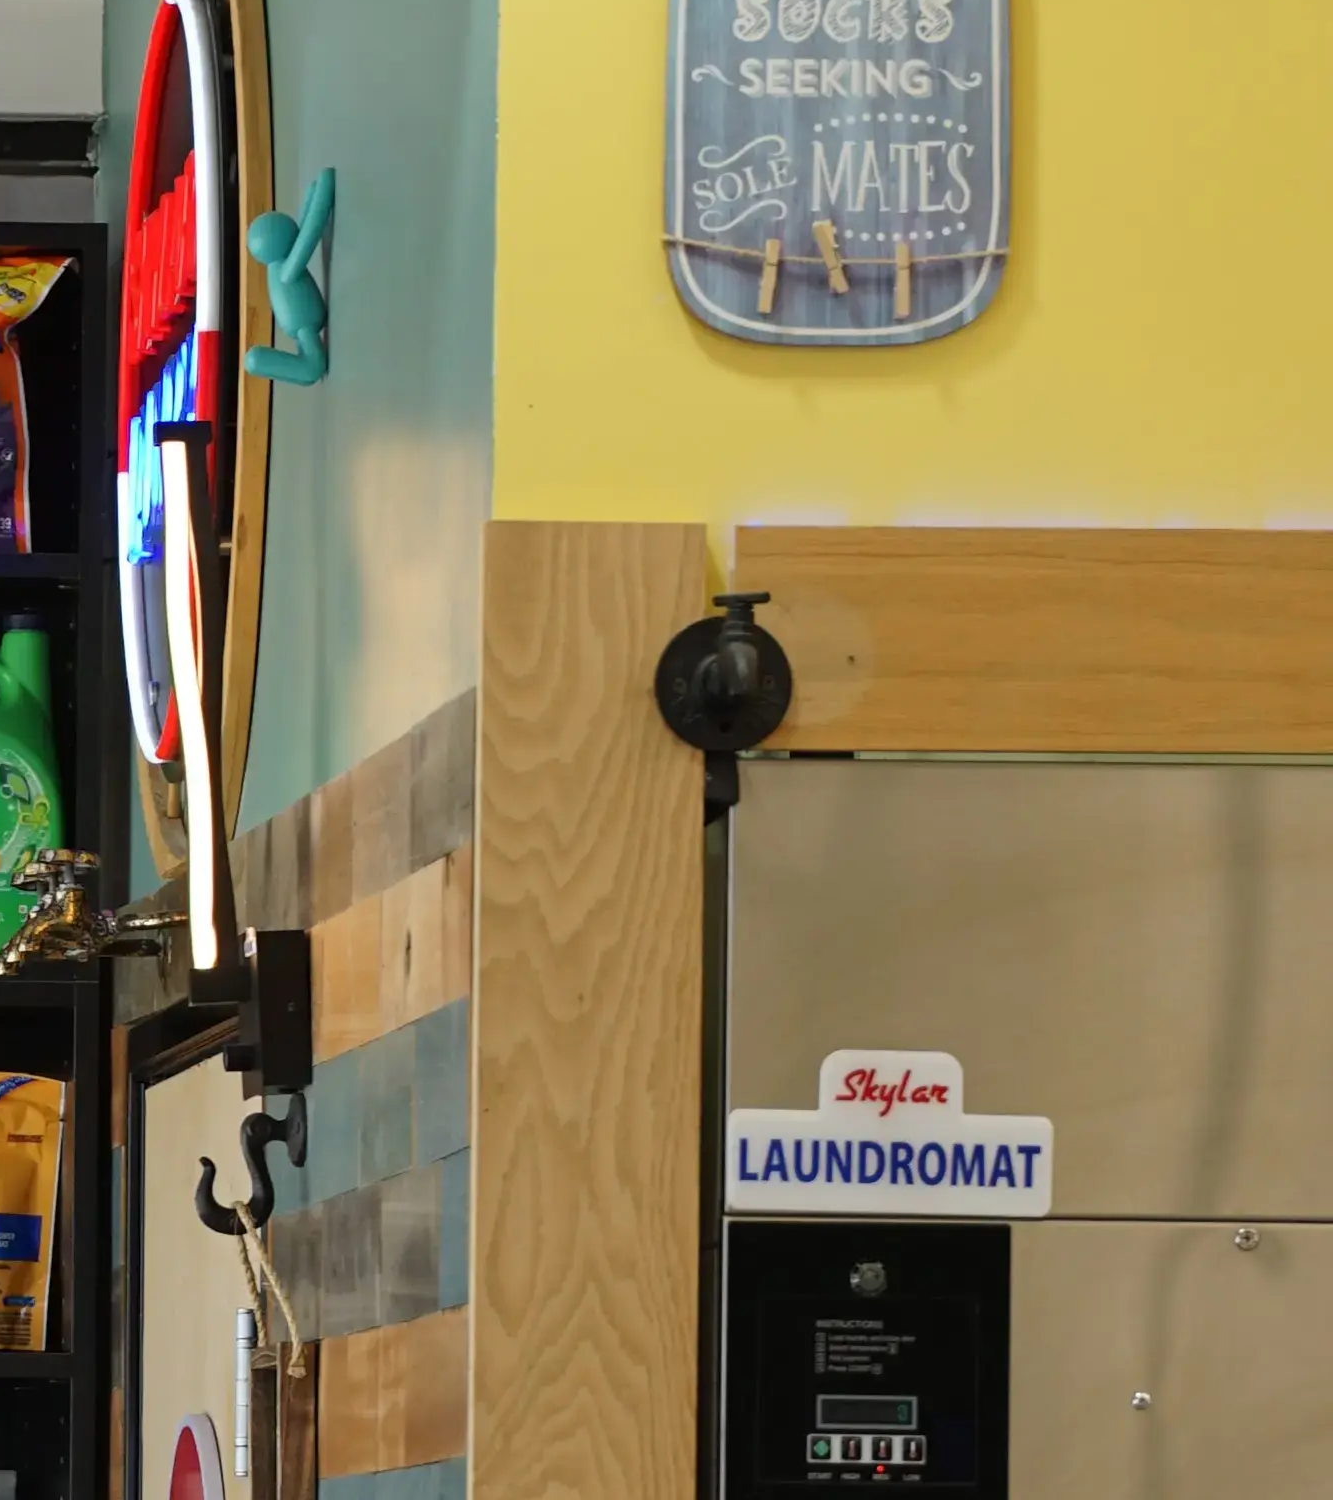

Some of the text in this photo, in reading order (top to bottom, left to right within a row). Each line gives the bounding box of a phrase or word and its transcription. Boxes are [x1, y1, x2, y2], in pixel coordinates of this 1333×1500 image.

[739, 58, 934, 99] SEEKING
[691, 140, 975, 215] SOLE MATES
[836, 1069, 947, 1116] Skylar
[739, 1138, 1040, 1188] LAUNDROMAT
